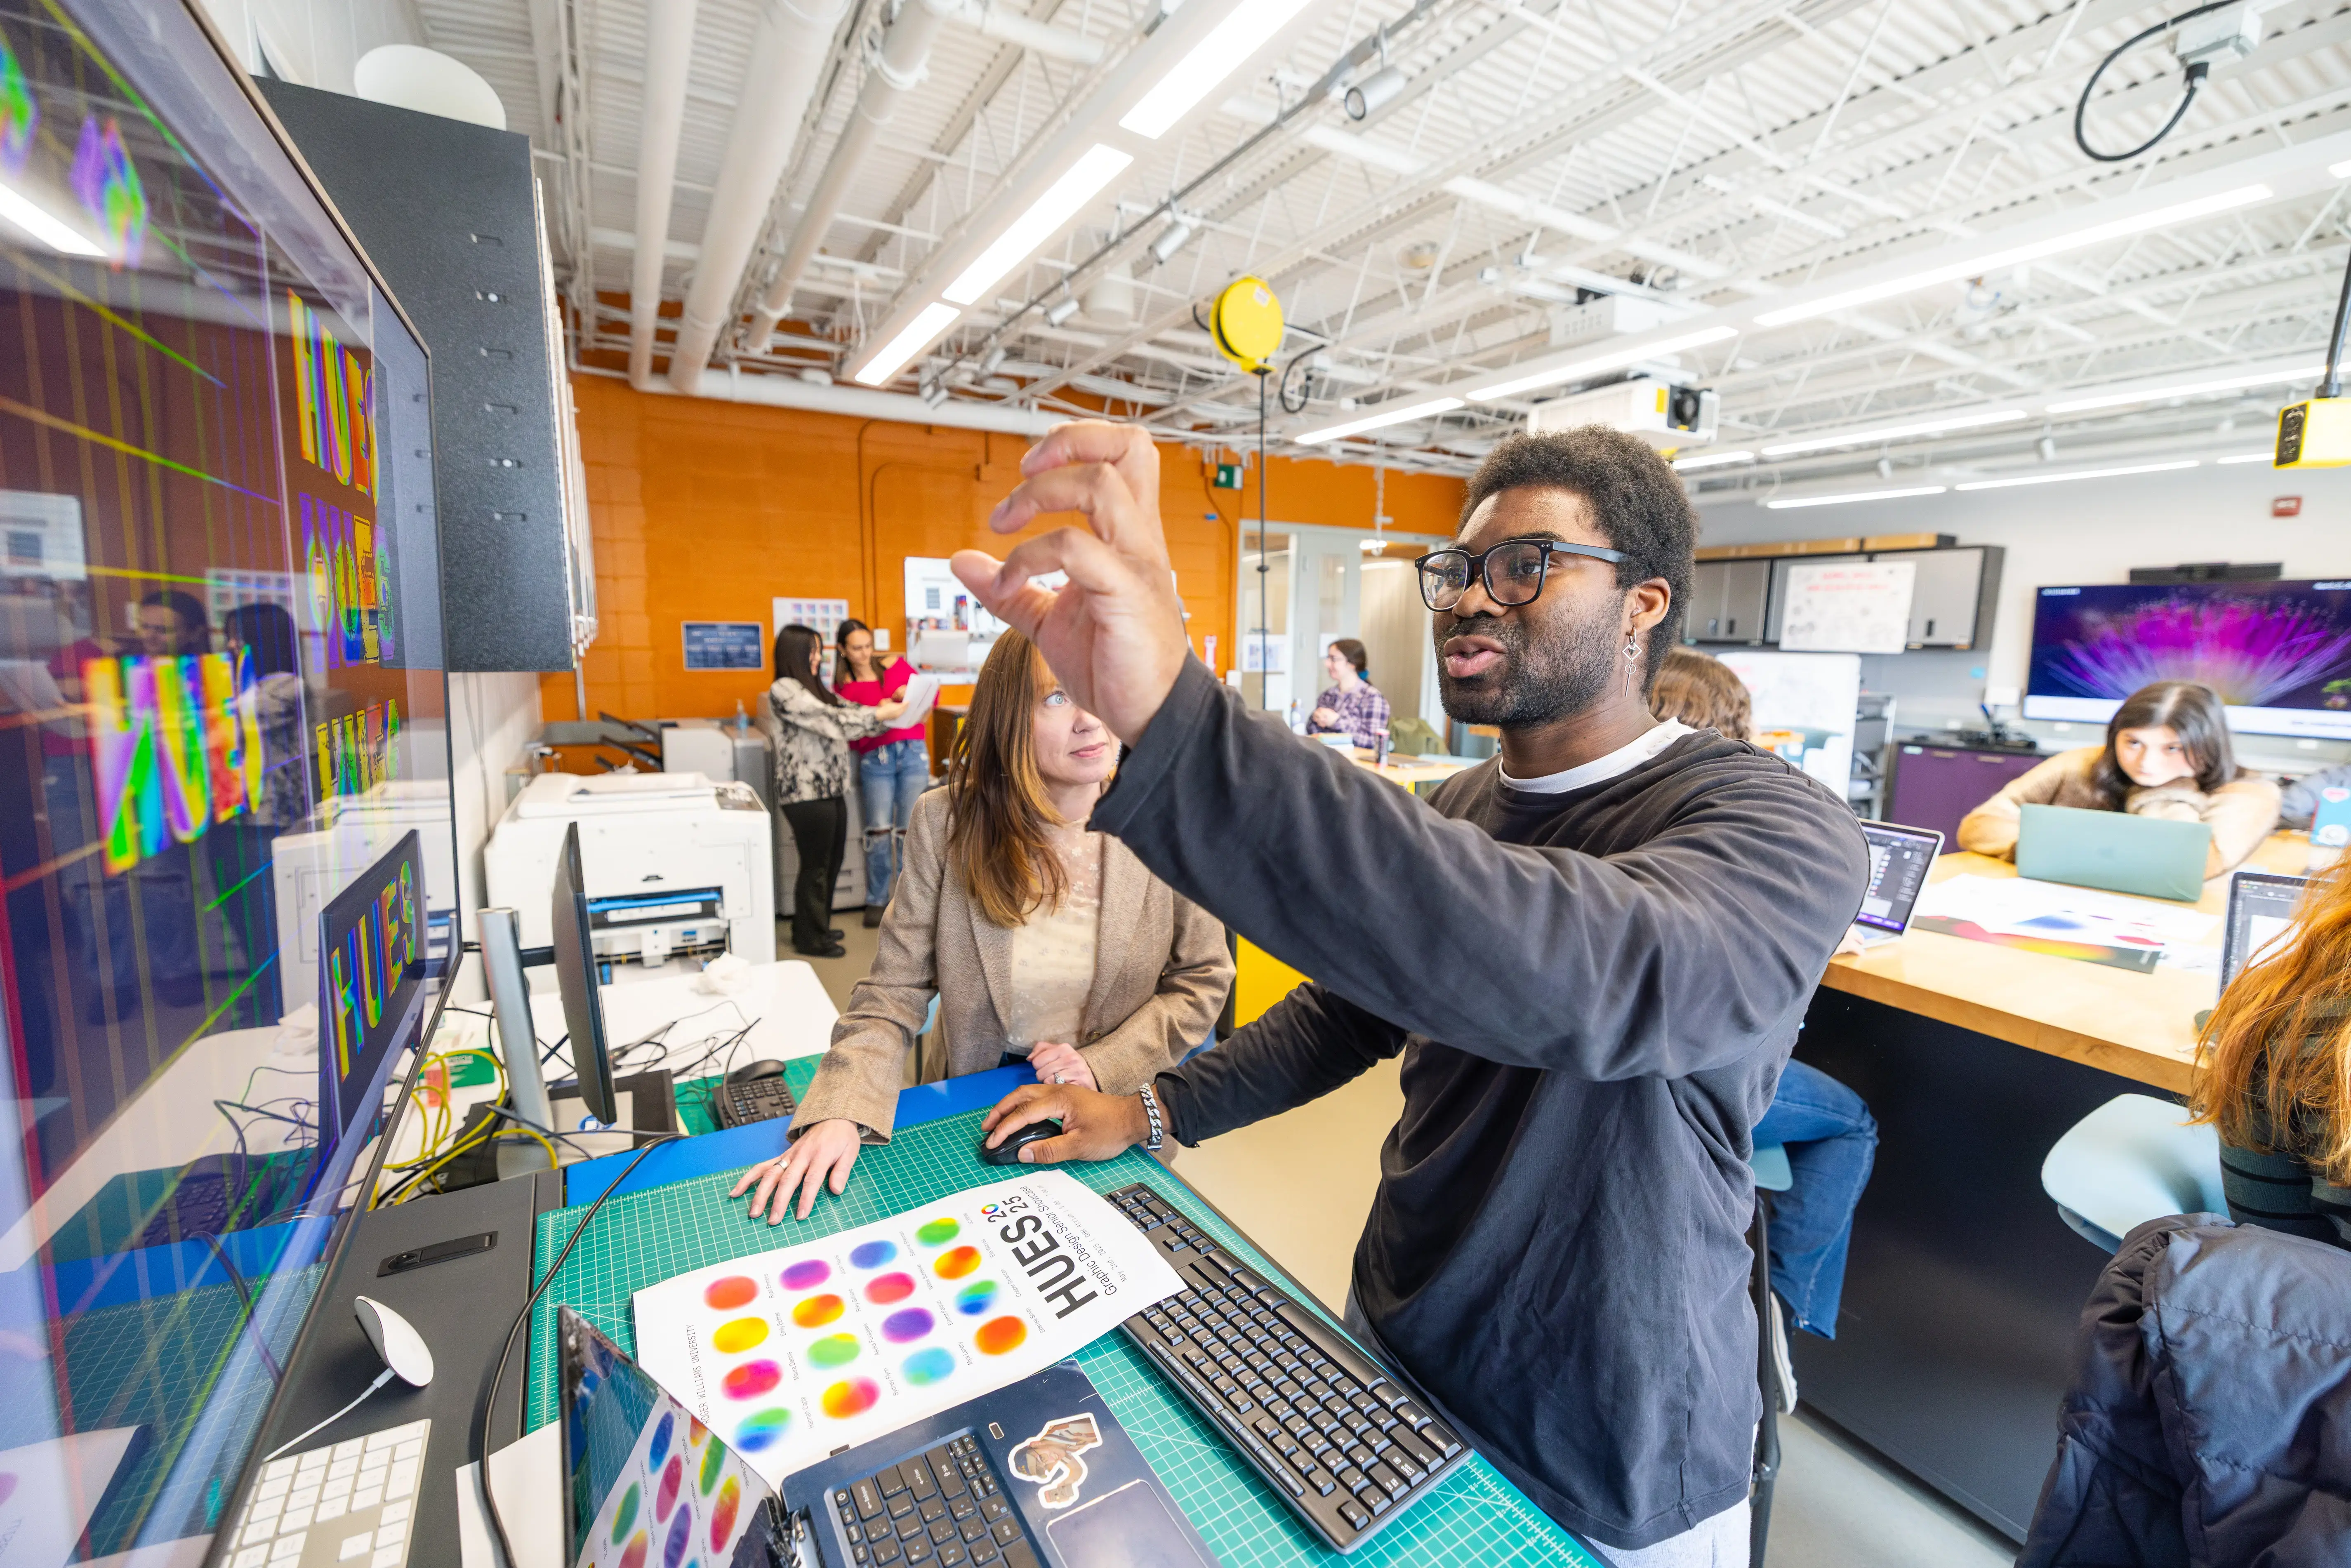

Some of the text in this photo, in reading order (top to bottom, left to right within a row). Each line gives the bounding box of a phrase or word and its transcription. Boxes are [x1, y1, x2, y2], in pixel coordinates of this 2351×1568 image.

[331, 860, 417, 1083] HUES
[981, 1204, 1008, 1223] 20
[1002, 1196, 1029, 1213] 25
[1069, 1213, 1083, 1228] Atrium
[1020, 1186, 1117, 1295] Graphic Design Senior Showcase
[1093, 1243, 1106, 1256] 2025
[1000, 1215, 1098, 1320] HUES
[1117, 1271, 1128, 1281] May
[763, 1274, 772, 1288] Emmons
[1001, 1268, 1021, 1297] Cooper Swanson
[943, 1312, 953, 1326] Emmit
[1026, 1307, 1045, 1334] Sherisa Smith
[778, 1325, 786, 1337] Emily
[863, 1323, 880, 1356] Asuka Fukagawa
[958, 1341, 974, 1366] Mya Landry
[686, 1325, 711, 1424] ROGER WILLIAMS UNIVERSITY
[787, 1351, 799, 1380] Maura Dennis
[883, 1367, 899, 1396] Sydney Flynn
[800, 1396, 815, 1429] Hannah Caple
[1436, 1439, 1447, 1449] Ctrl
[1418, 1453, 1430, 1463] Shift
[1400, 1465, 1412, 1476] Caps
[1404, 1463, 1416, 1474] Lock
[1385, 1481, 1394, 1491] Tab
